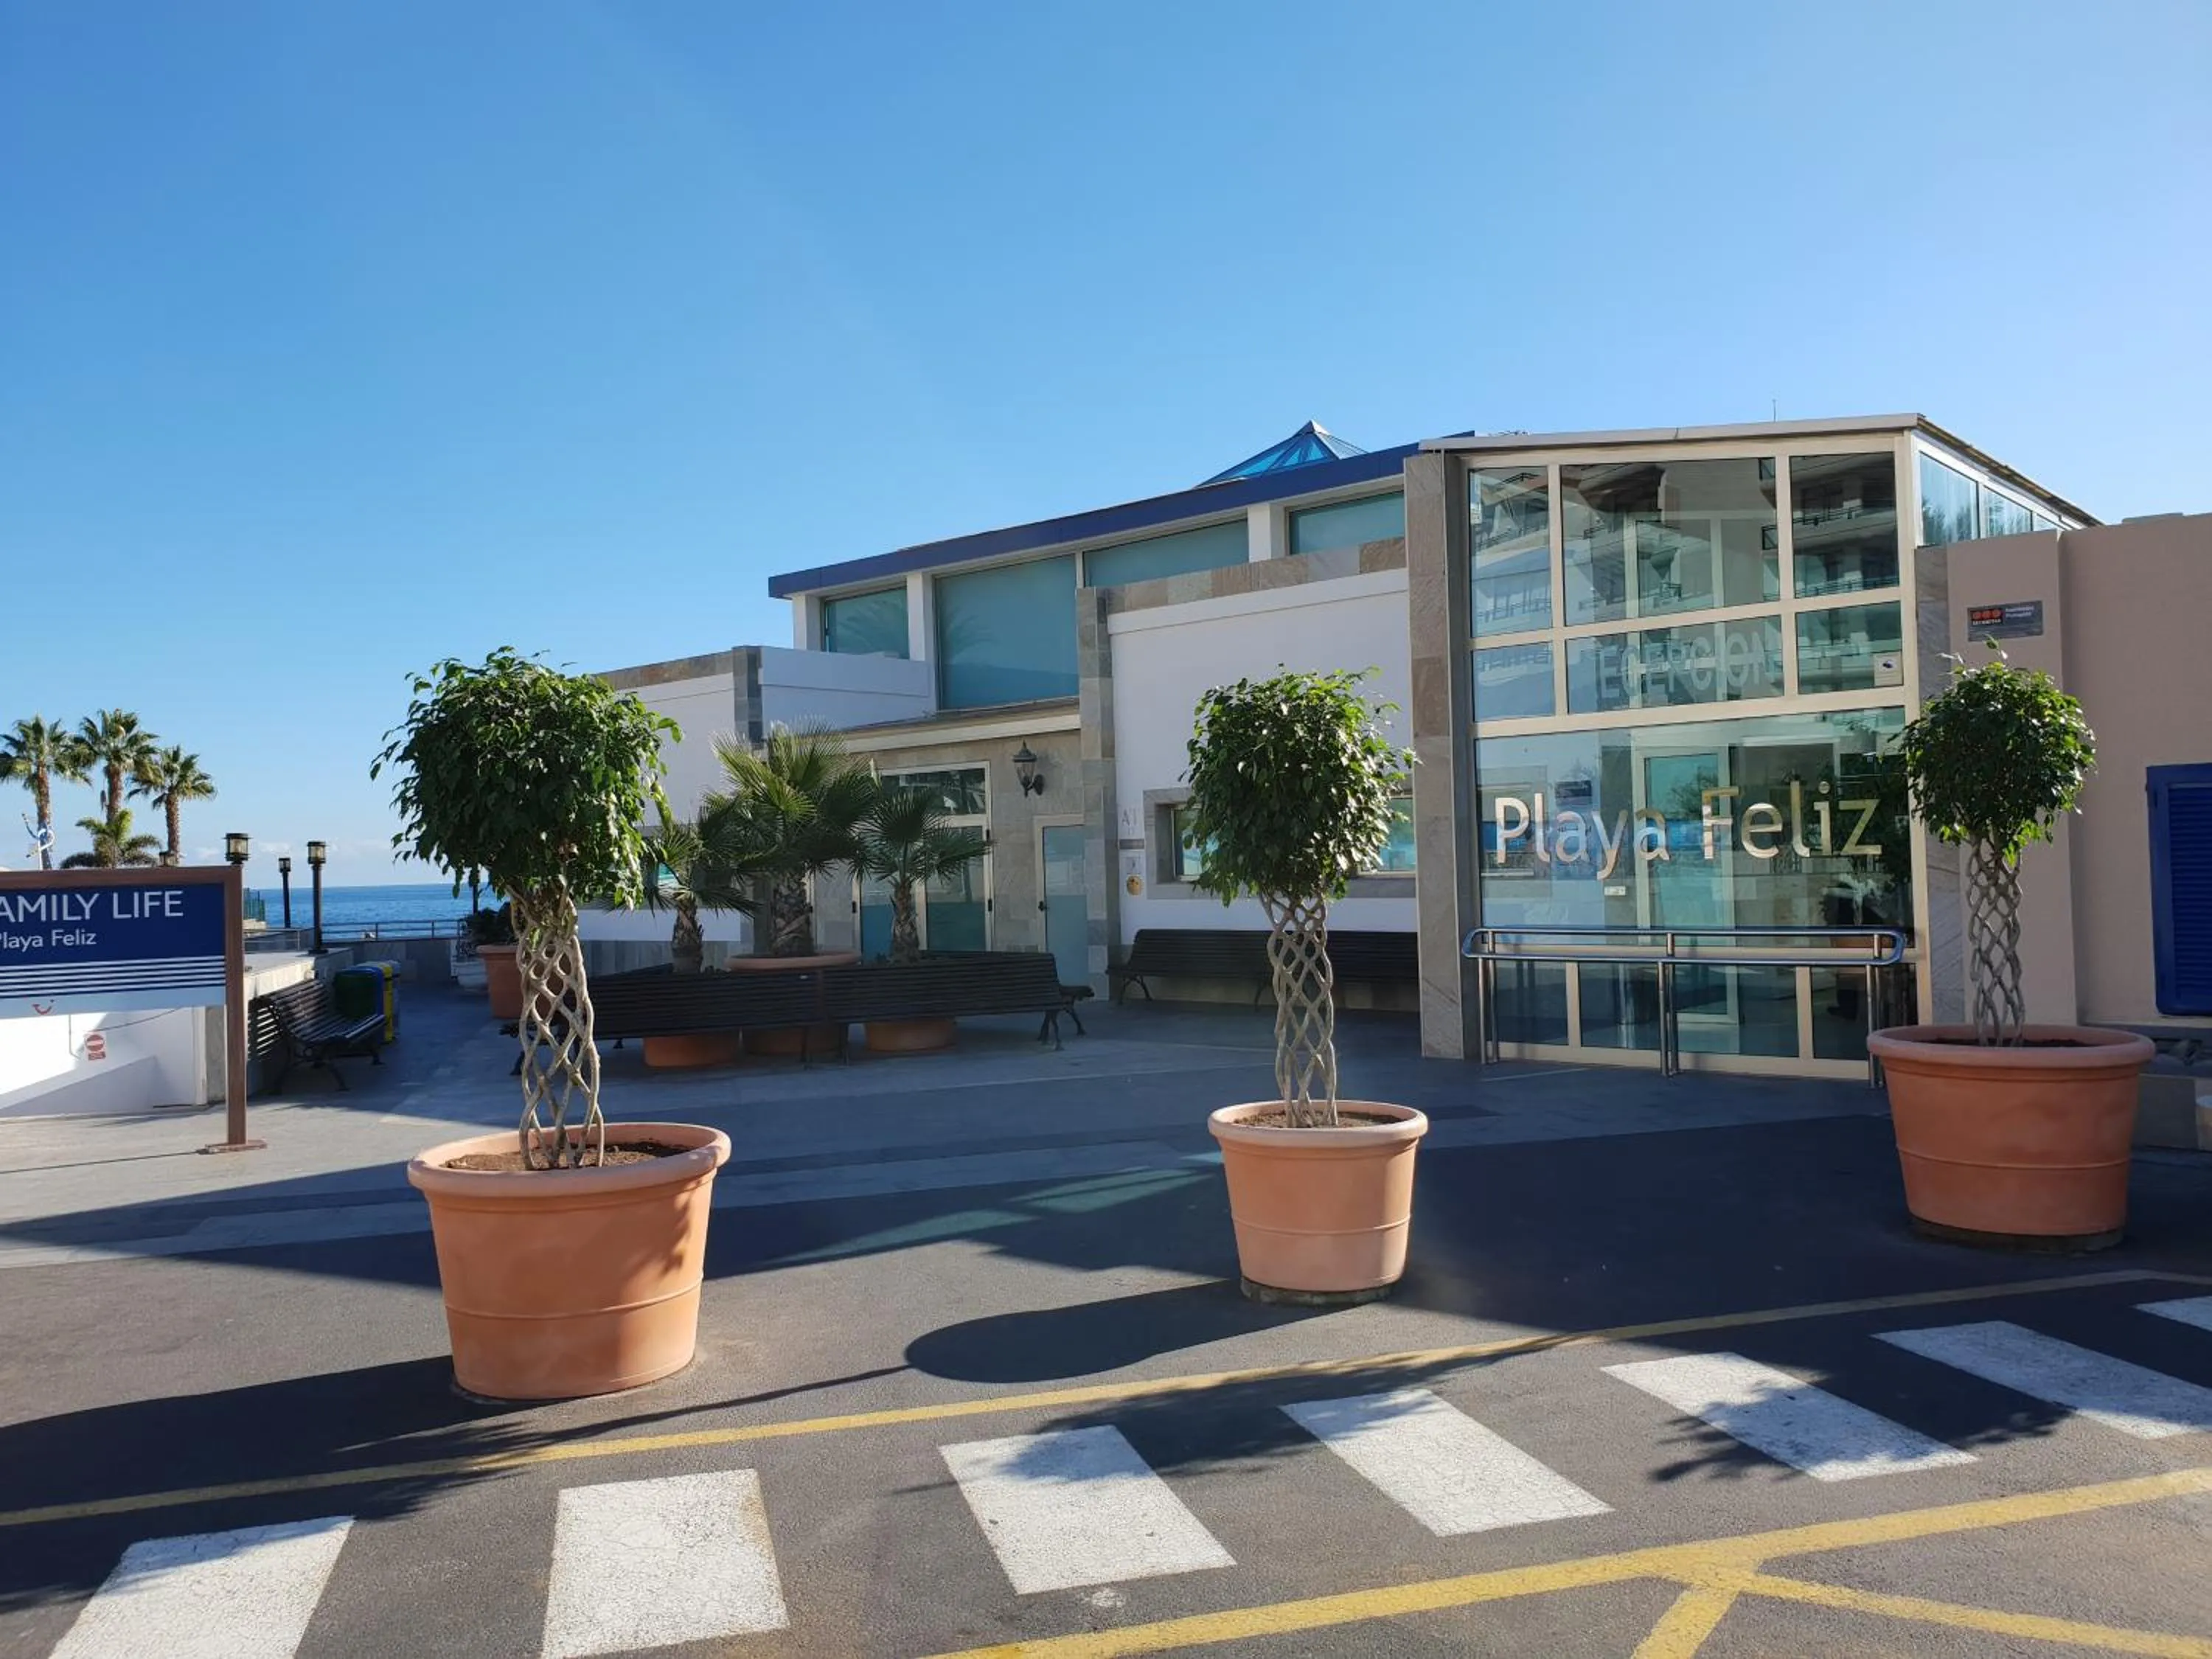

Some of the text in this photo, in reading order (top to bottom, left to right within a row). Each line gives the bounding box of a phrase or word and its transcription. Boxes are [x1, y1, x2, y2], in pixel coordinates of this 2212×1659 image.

[1593, 631, 1775, 698] ECEPCION
[1495, 780, 1882, 880] Playa Feliz
[112, 890, 184, 919] LIFE
[0, 929, 97, 953] laya Feliz
